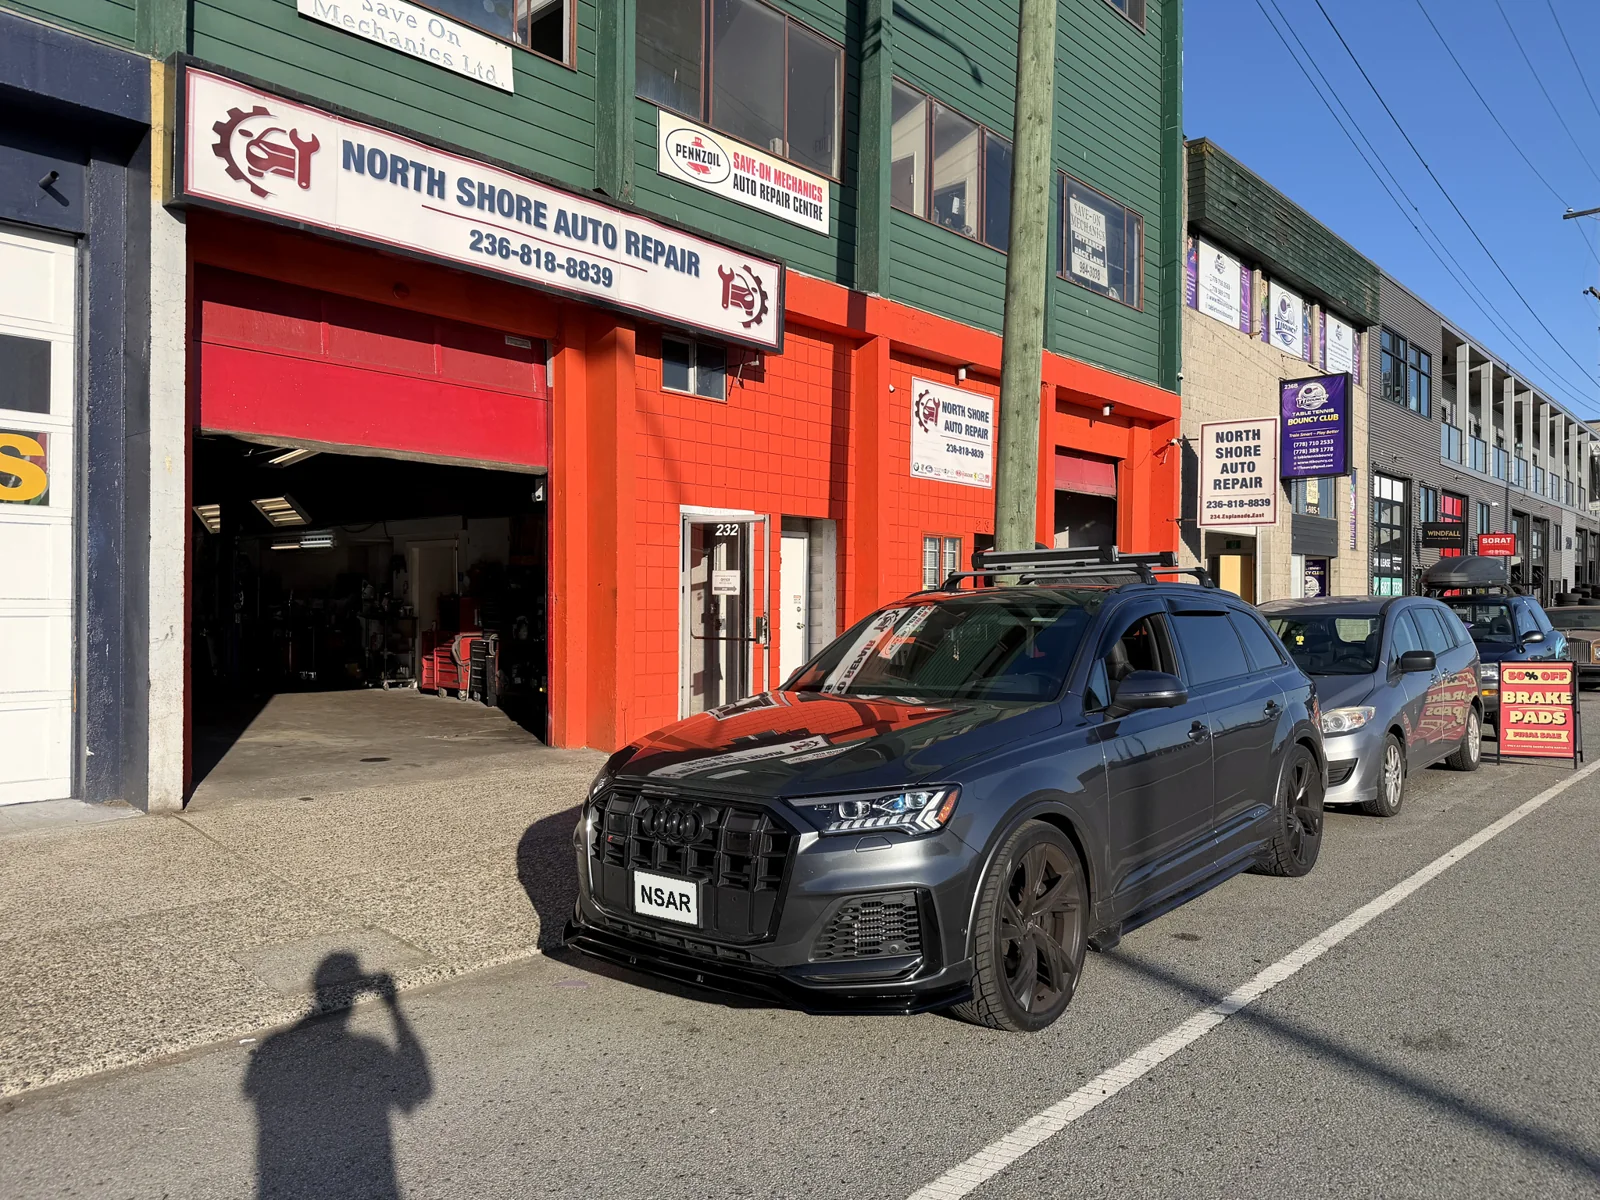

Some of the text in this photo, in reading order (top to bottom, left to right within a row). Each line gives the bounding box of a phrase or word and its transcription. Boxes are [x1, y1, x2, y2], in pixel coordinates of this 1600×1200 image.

[428, 18, 462, 47] On
[312, 0, 505, 87] Mechanics Ltd.
[676, 143, 721, 167] PENNZOIL
[733, 151, 823, 203] SAVE-ON MECHANICS
[733, 173, 823, 221] AUTO REPAIR CENTRE
[342, 139, 701, 278] NORTH SHORE AUTO REPAIR
[1073, 202, 1101, 227] SAVE-ON
[1071, 215, 1106, 241] MECHANICS
[469, 229, 614, 288] 236-818-8839
[1074, 246, 1104, 267] BACK LANE
[942, 401, 989, 423] NORTH SHORE
[1288, 416, 1318, 426] BOUNCY
[944, 420, 988, 440] AUTO REPAIR
[1215, 429, 1261, 443] NORTH
[946, 443, 984, 459] 236-818-8839
[1215, 445, 1261, 459] SHORE
[1220, 461, 1256, 474] AUTO
[1213, 477, 1263, 490] REPAIR
[1206, 498, 1271, 509] 236-818-8839
[715, 524, 739, 536] 232
[1508, 671, 1568, 681] 50% OFF
[1502, 691, 1573, 705] BRAKE
[1509, 710, 1567, 725] PADS
[1513, 731, 1539, 739] FINAL
[641, 884, 691, 913] NSAR
